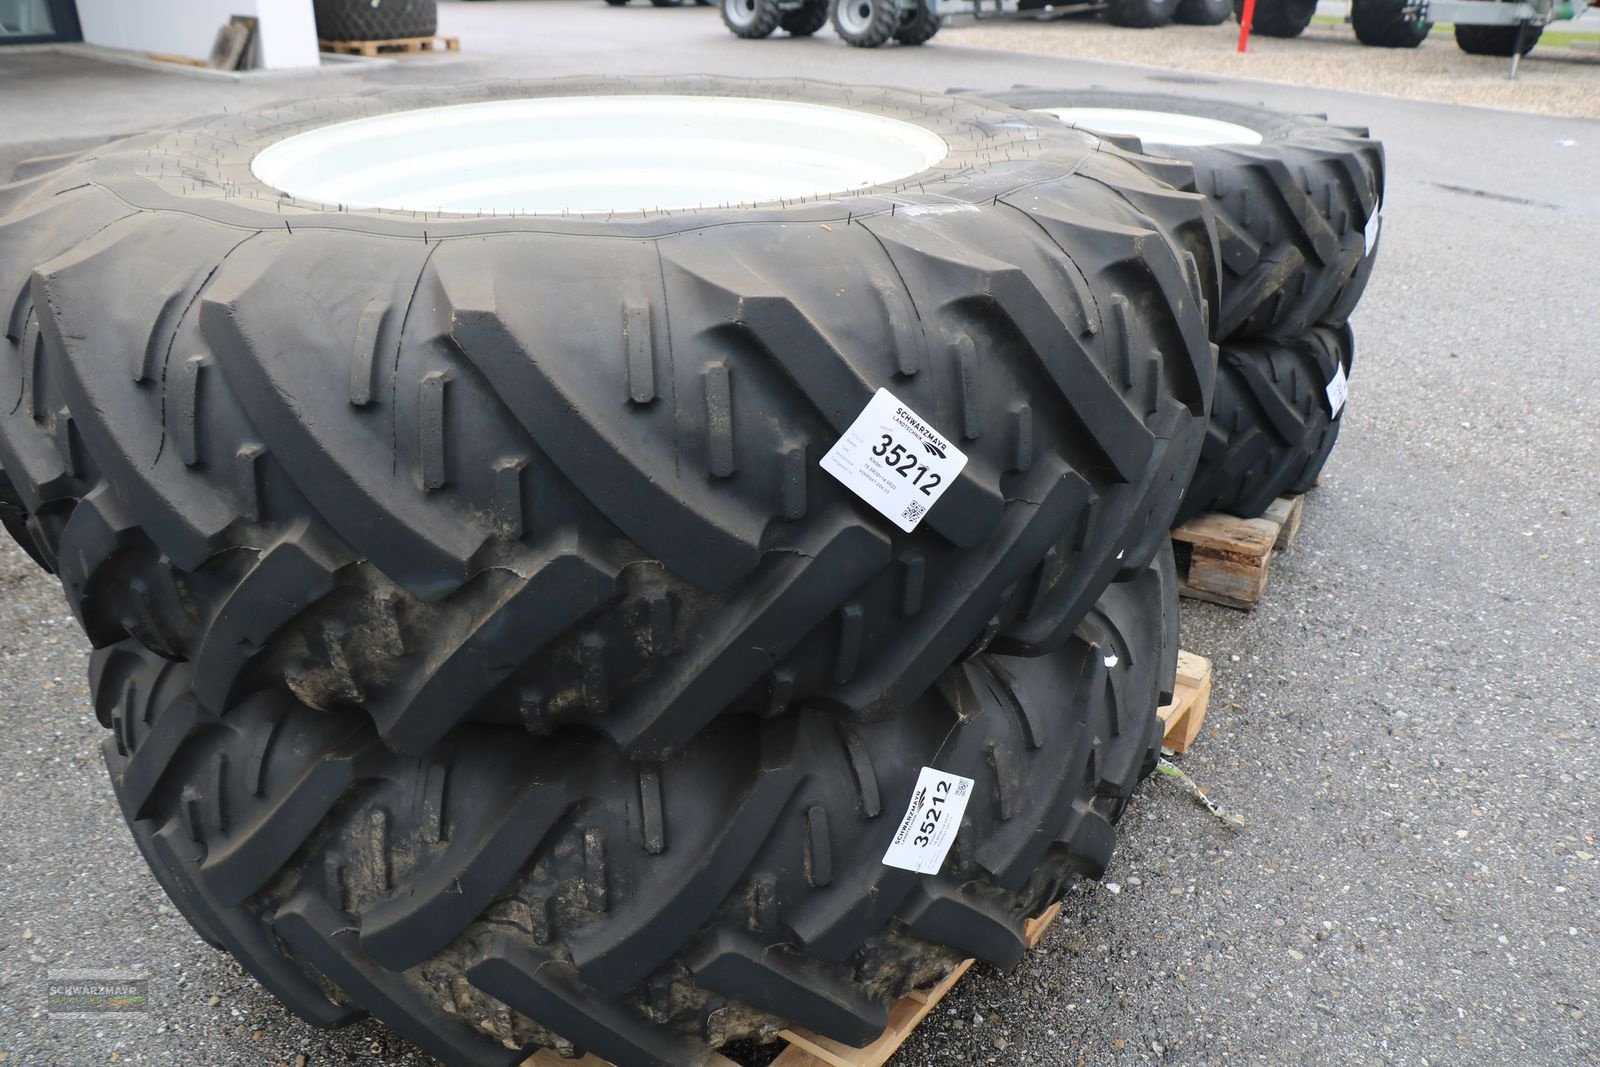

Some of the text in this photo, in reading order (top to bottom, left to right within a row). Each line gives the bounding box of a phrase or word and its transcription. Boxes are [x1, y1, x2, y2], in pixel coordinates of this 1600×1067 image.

[892, 415, 923, 441] LANDTECHNIK
[896, 407, 947, 451] SCHWARZMAYR
[872, 433, 942, 496] 35212
[895, 790, 921, 845] SCHWARZMAYR
[913, 780, 952, 848] 35212
